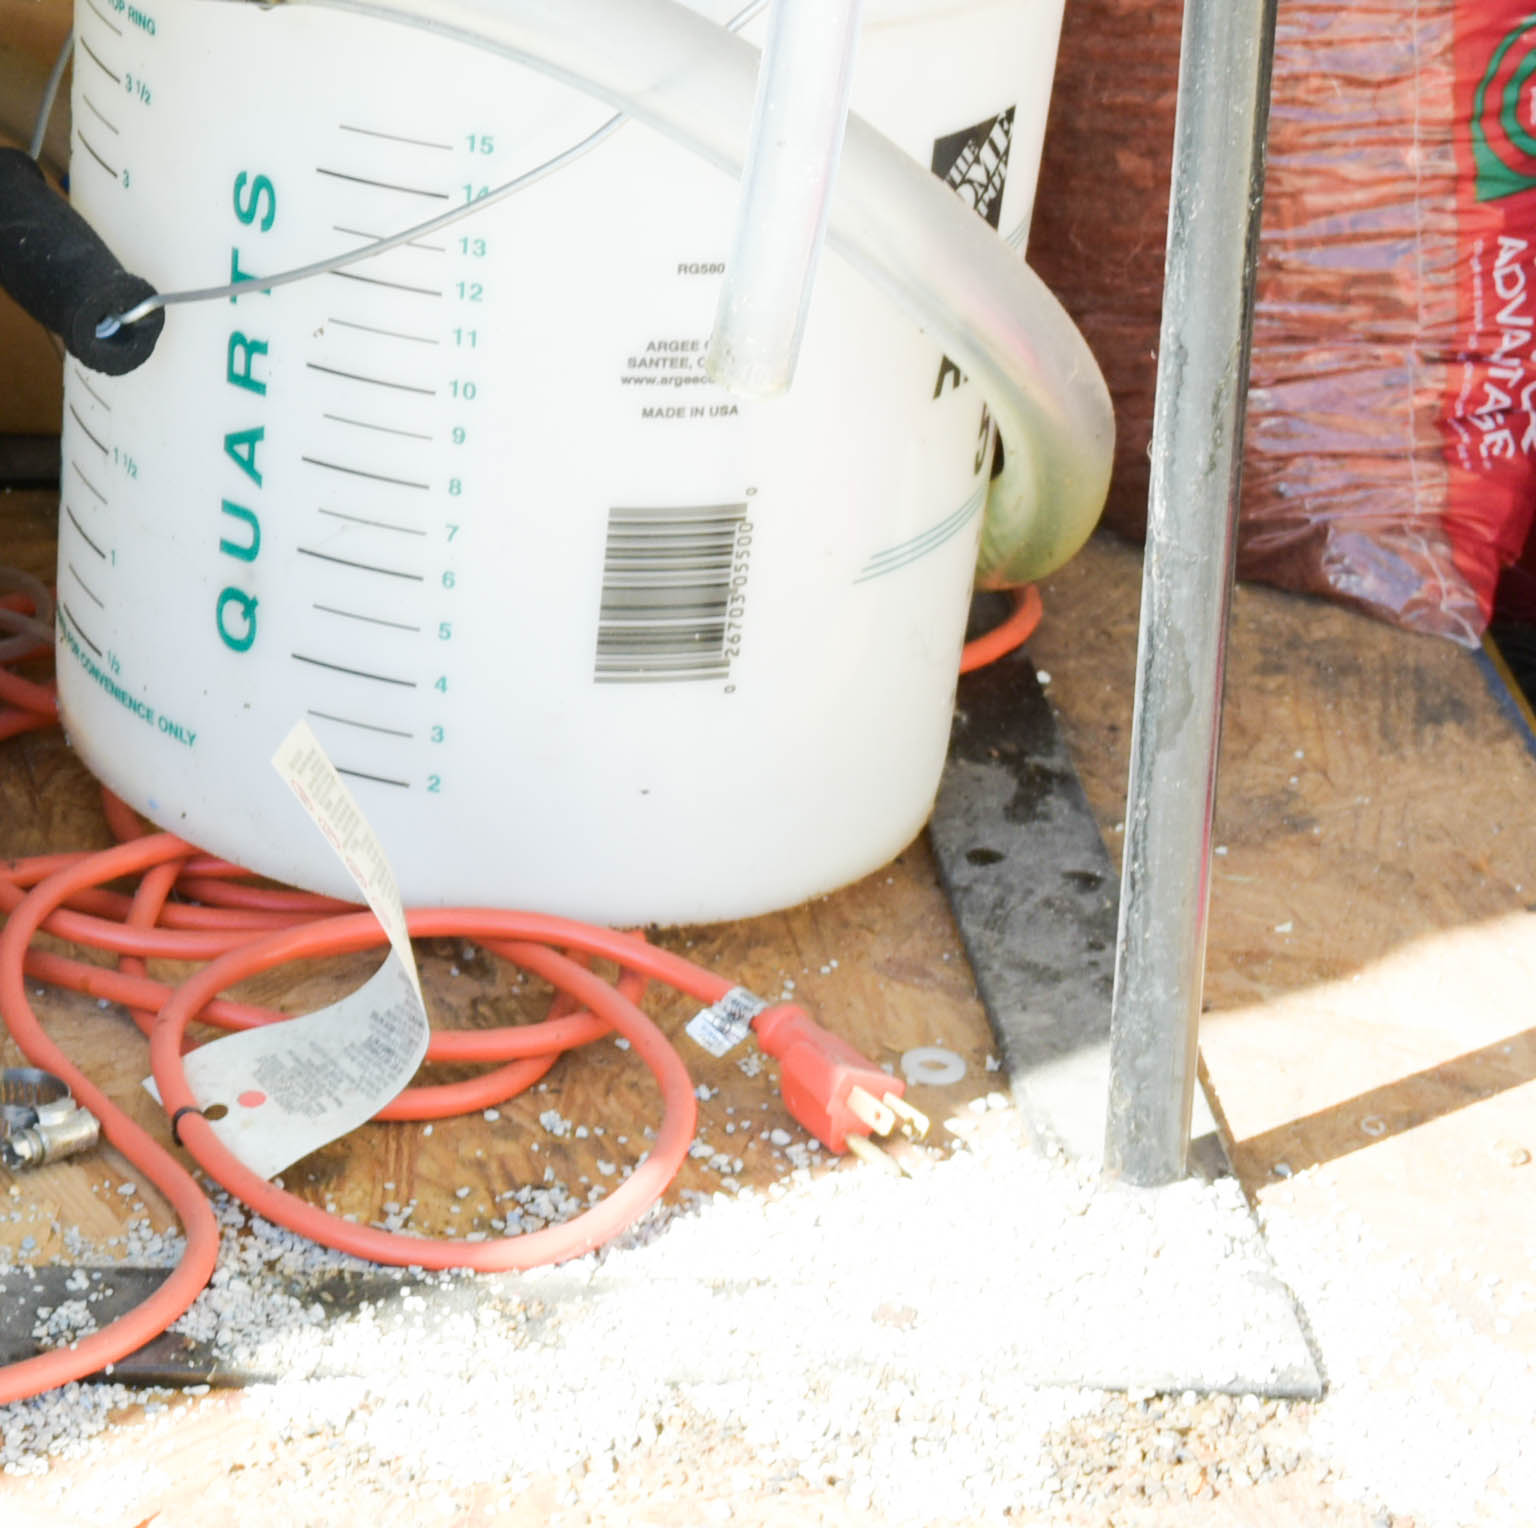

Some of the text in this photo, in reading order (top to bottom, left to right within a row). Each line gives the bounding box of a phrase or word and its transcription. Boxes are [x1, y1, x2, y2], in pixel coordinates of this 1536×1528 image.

[127, 6, 157, 37] RING
[135, 79, 153, 106] 1/2
[465, 132, 496, 156] 15
[122, 168, 131, 189] 3
[458, 235, 488, 259] 13
[456, 280, 484, 303] 12
[452, 326, 480, 350] 11
[645, 340, 701, 353] ARGEE
[627, 357, 694, 371] SANTEE,
[449, 378, 478, 402] 10
[215, 169, 277, 654] QUARTS
[641, 404, 740, 420] MADE IN USA
[451, 426, 467, 447] 9
[448, 477, 463, 498] 8
[445, 523, 460, 543] 7
[110, 549, 117, 568] 1
[441, 570, 456, 590] 6
[438, 621, 452, 642] 5
[106, 649, 122, 676] 1/2
[434, 675, 449, 695] 4
[81, 649, 156, 728] CONVENIENCE
[157, 712, 198, 749] ONLY
[430, 724, 445, 745] 3
[427, 774, 442, 794] 2
